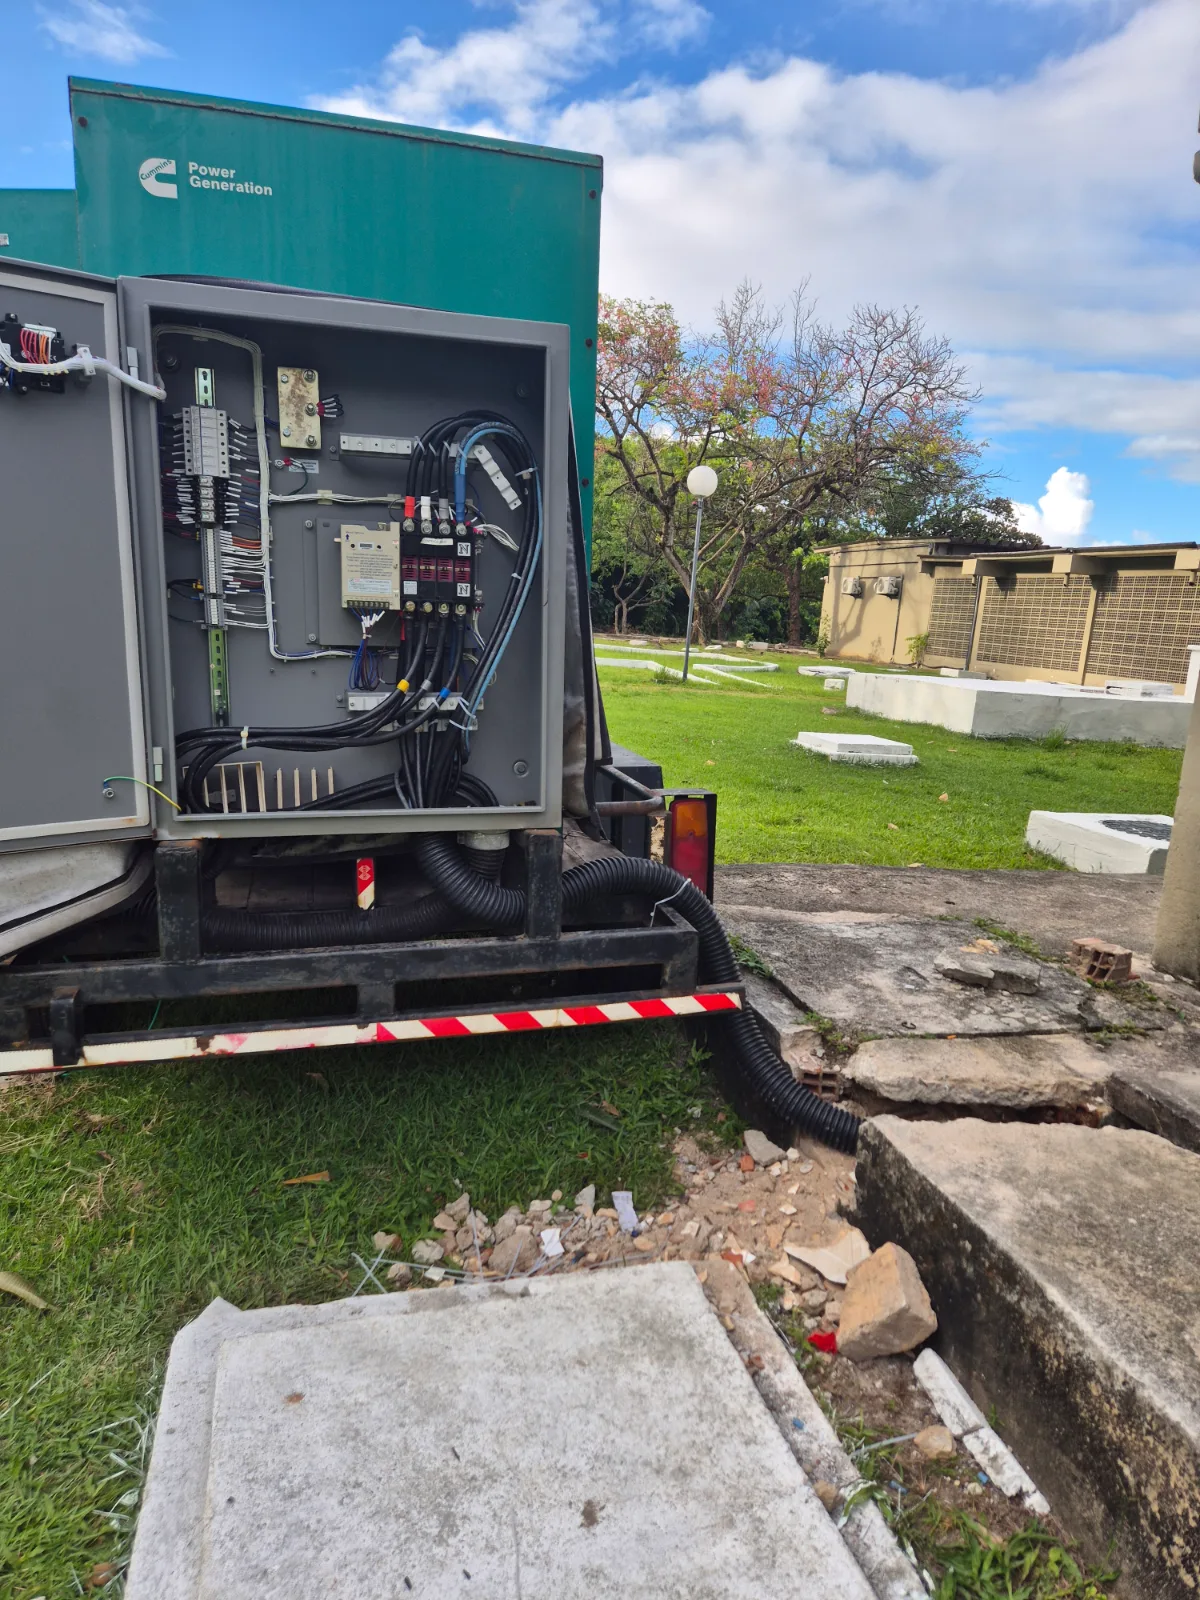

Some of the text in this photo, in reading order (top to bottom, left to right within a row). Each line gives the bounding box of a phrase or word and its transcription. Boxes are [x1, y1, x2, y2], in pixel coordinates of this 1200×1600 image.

[140, 159, 172, 180] Cummins
[188, 162, 236, 178] Power
[189, 175, 273, 196] Generation
[458, 543, 470, 555] N
[458, 584, 469, 595] N
